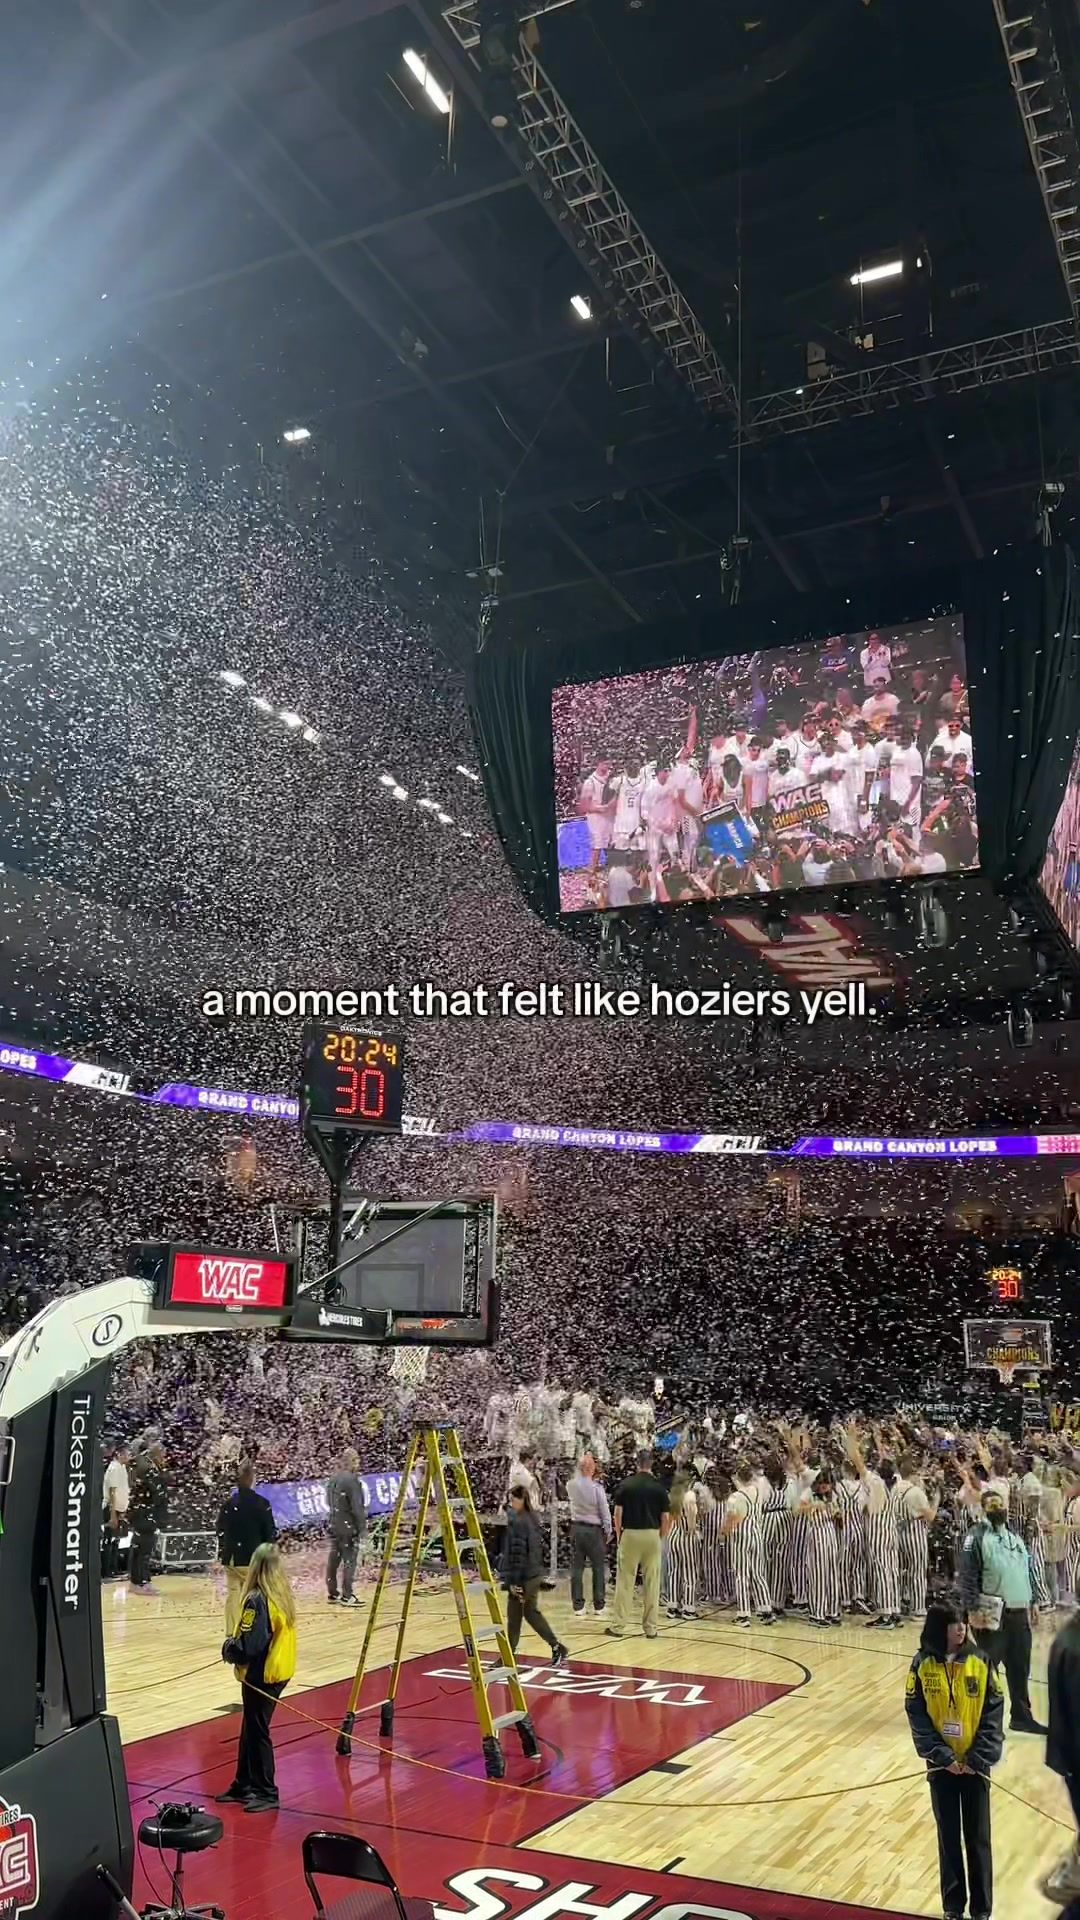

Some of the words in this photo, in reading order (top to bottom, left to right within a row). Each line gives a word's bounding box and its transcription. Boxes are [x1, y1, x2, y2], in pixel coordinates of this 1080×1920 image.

[772, 801, 829, 829] CHAMPIONS
[323, 1033, 397, 1066] 20:24
[198, 1091, 248, 1110] GRAND
[335, 1065, 385, 1118] 30
[512, 1126, 560, 1140] GRAND
[563, 1129, 616, 1145] CANYON
[619, 1133, 661, 1148] LOPES
[833, 1139, 885, 1152] GRAND
[887, 1140, 946, 1153] CANYON
[949, 1140, 997, 1153] LOPES
[198, 1258, 264, 1301] WAC
[998, 1280, 1018, 1298] 30
[64, 1394, 91, 1609] TicketSmarter
